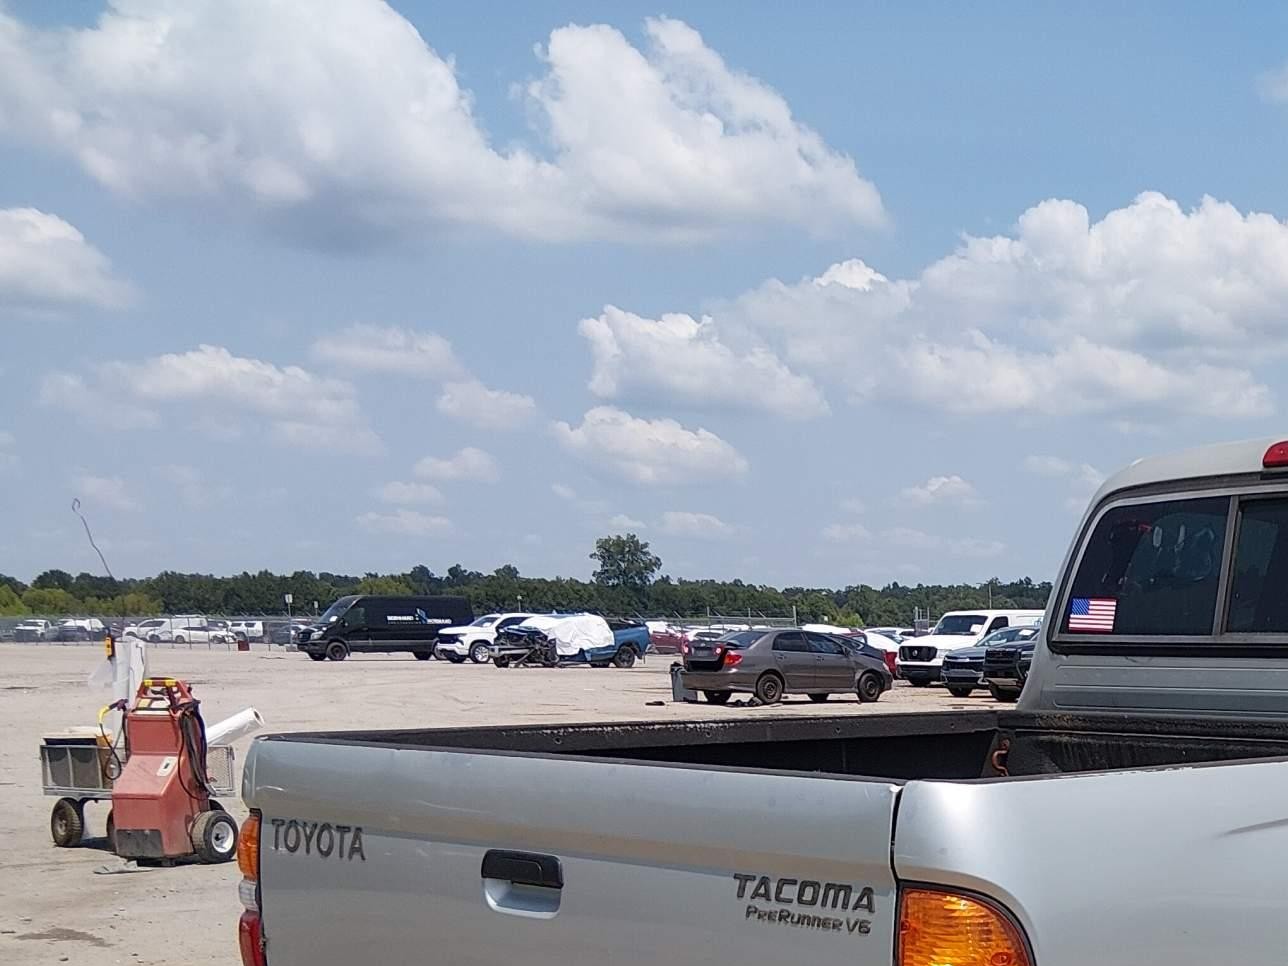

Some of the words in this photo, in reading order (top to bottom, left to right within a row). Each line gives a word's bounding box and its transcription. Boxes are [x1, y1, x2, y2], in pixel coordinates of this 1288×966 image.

[271, 818, 366, 861] TOYOTA
[733, 873, 875, 914] TACOMA
[846, 916, 873, 936] V6
